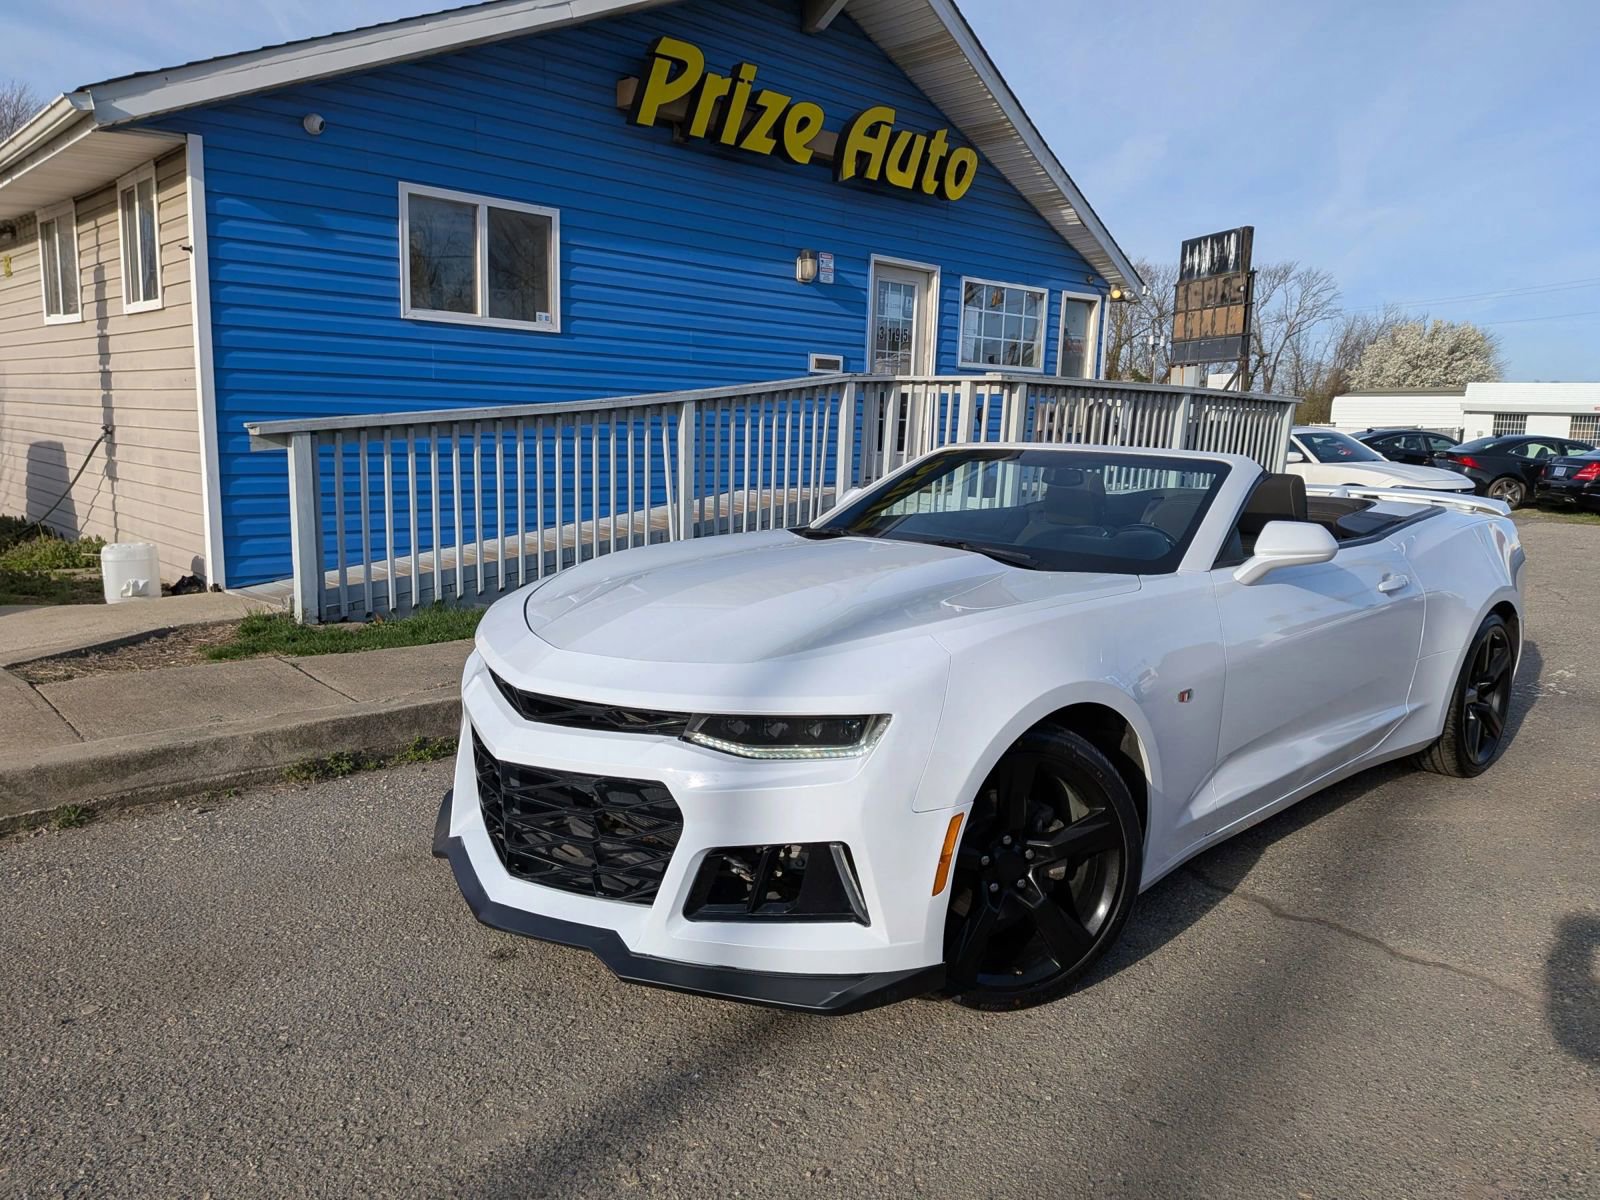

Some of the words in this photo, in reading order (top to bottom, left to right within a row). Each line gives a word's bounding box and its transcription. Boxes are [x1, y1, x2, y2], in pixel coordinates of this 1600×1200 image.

[634, 36, 825, 164] Prize
[841, 105, 979, 201] Auto
[879, 326, 908, 342] 3195
